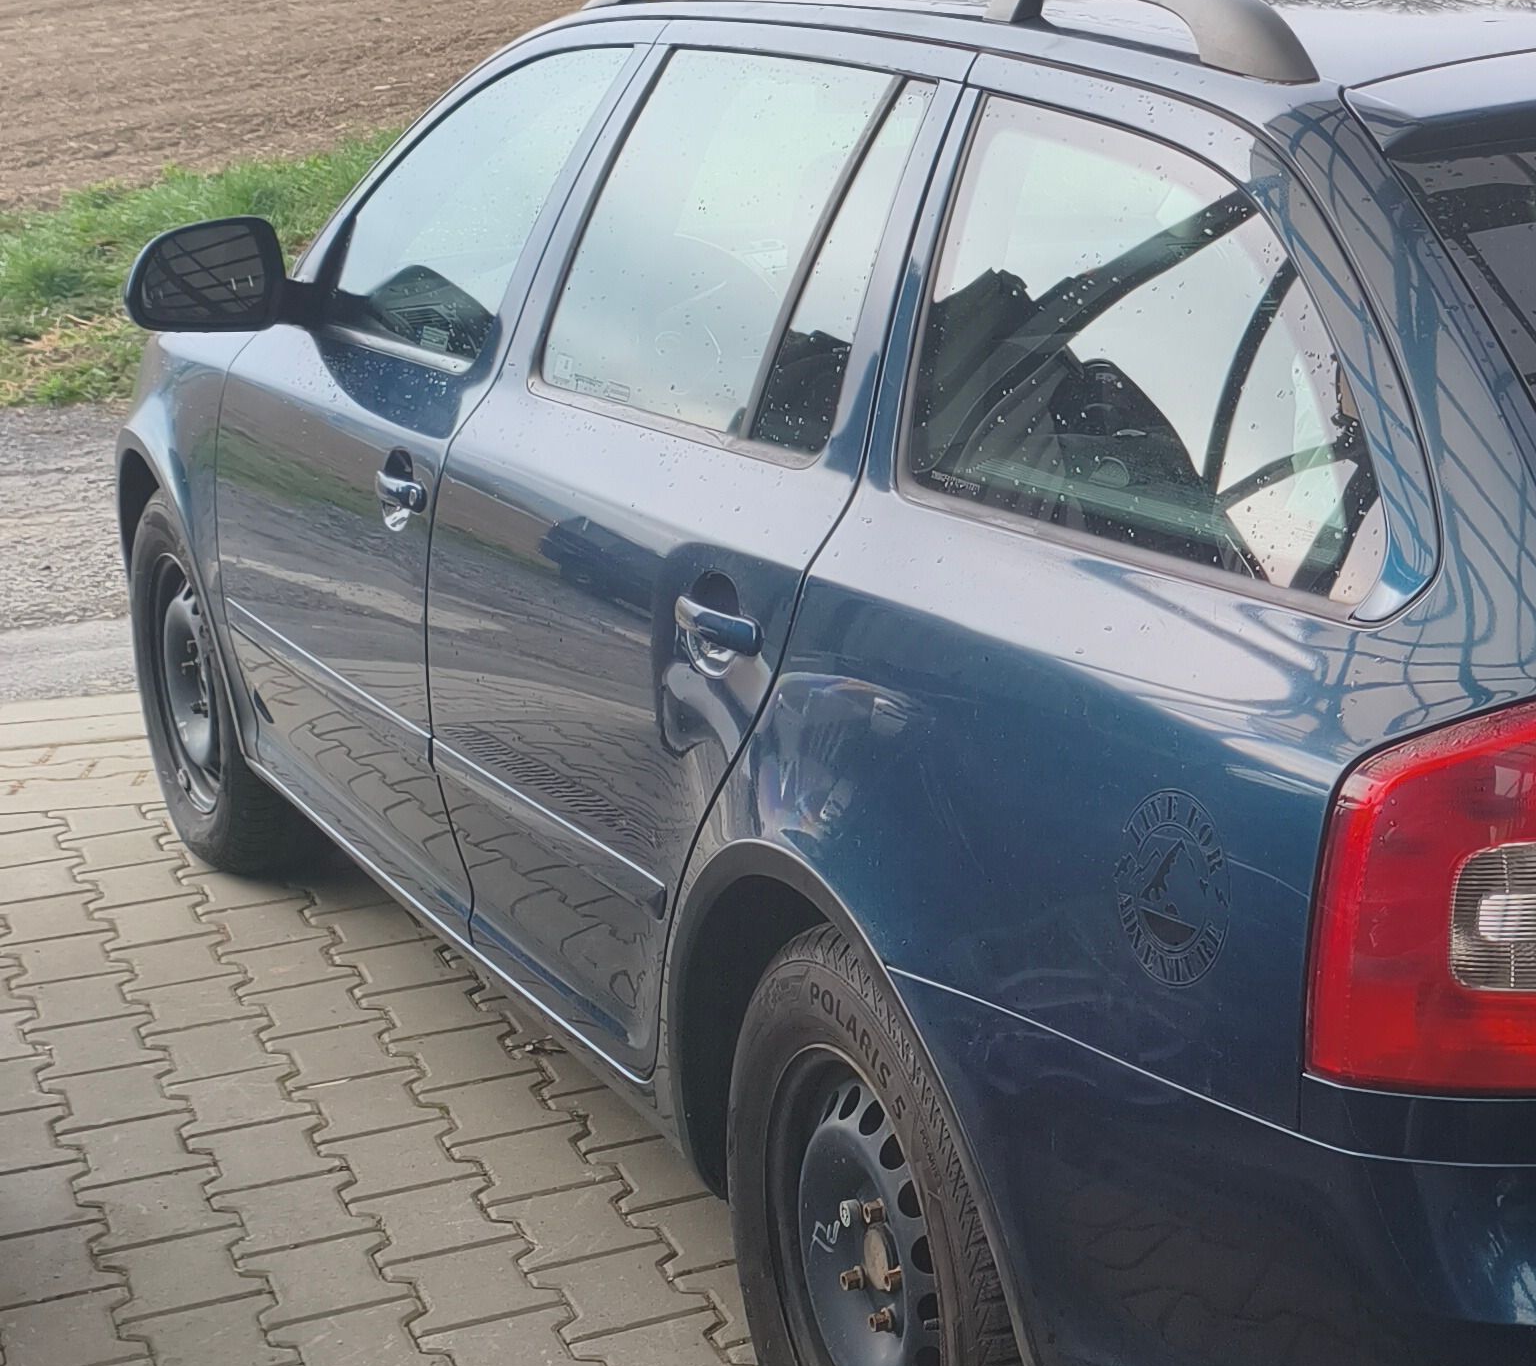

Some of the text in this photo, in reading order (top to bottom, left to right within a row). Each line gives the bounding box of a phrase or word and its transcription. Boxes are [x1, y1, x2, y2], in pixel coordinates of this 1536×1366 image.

[1187, 803, 1224, 875] FOR
[1117, 892, 1223, 983] ADVENTURE
[810, 981, 907, 1120] POLARIS 5
